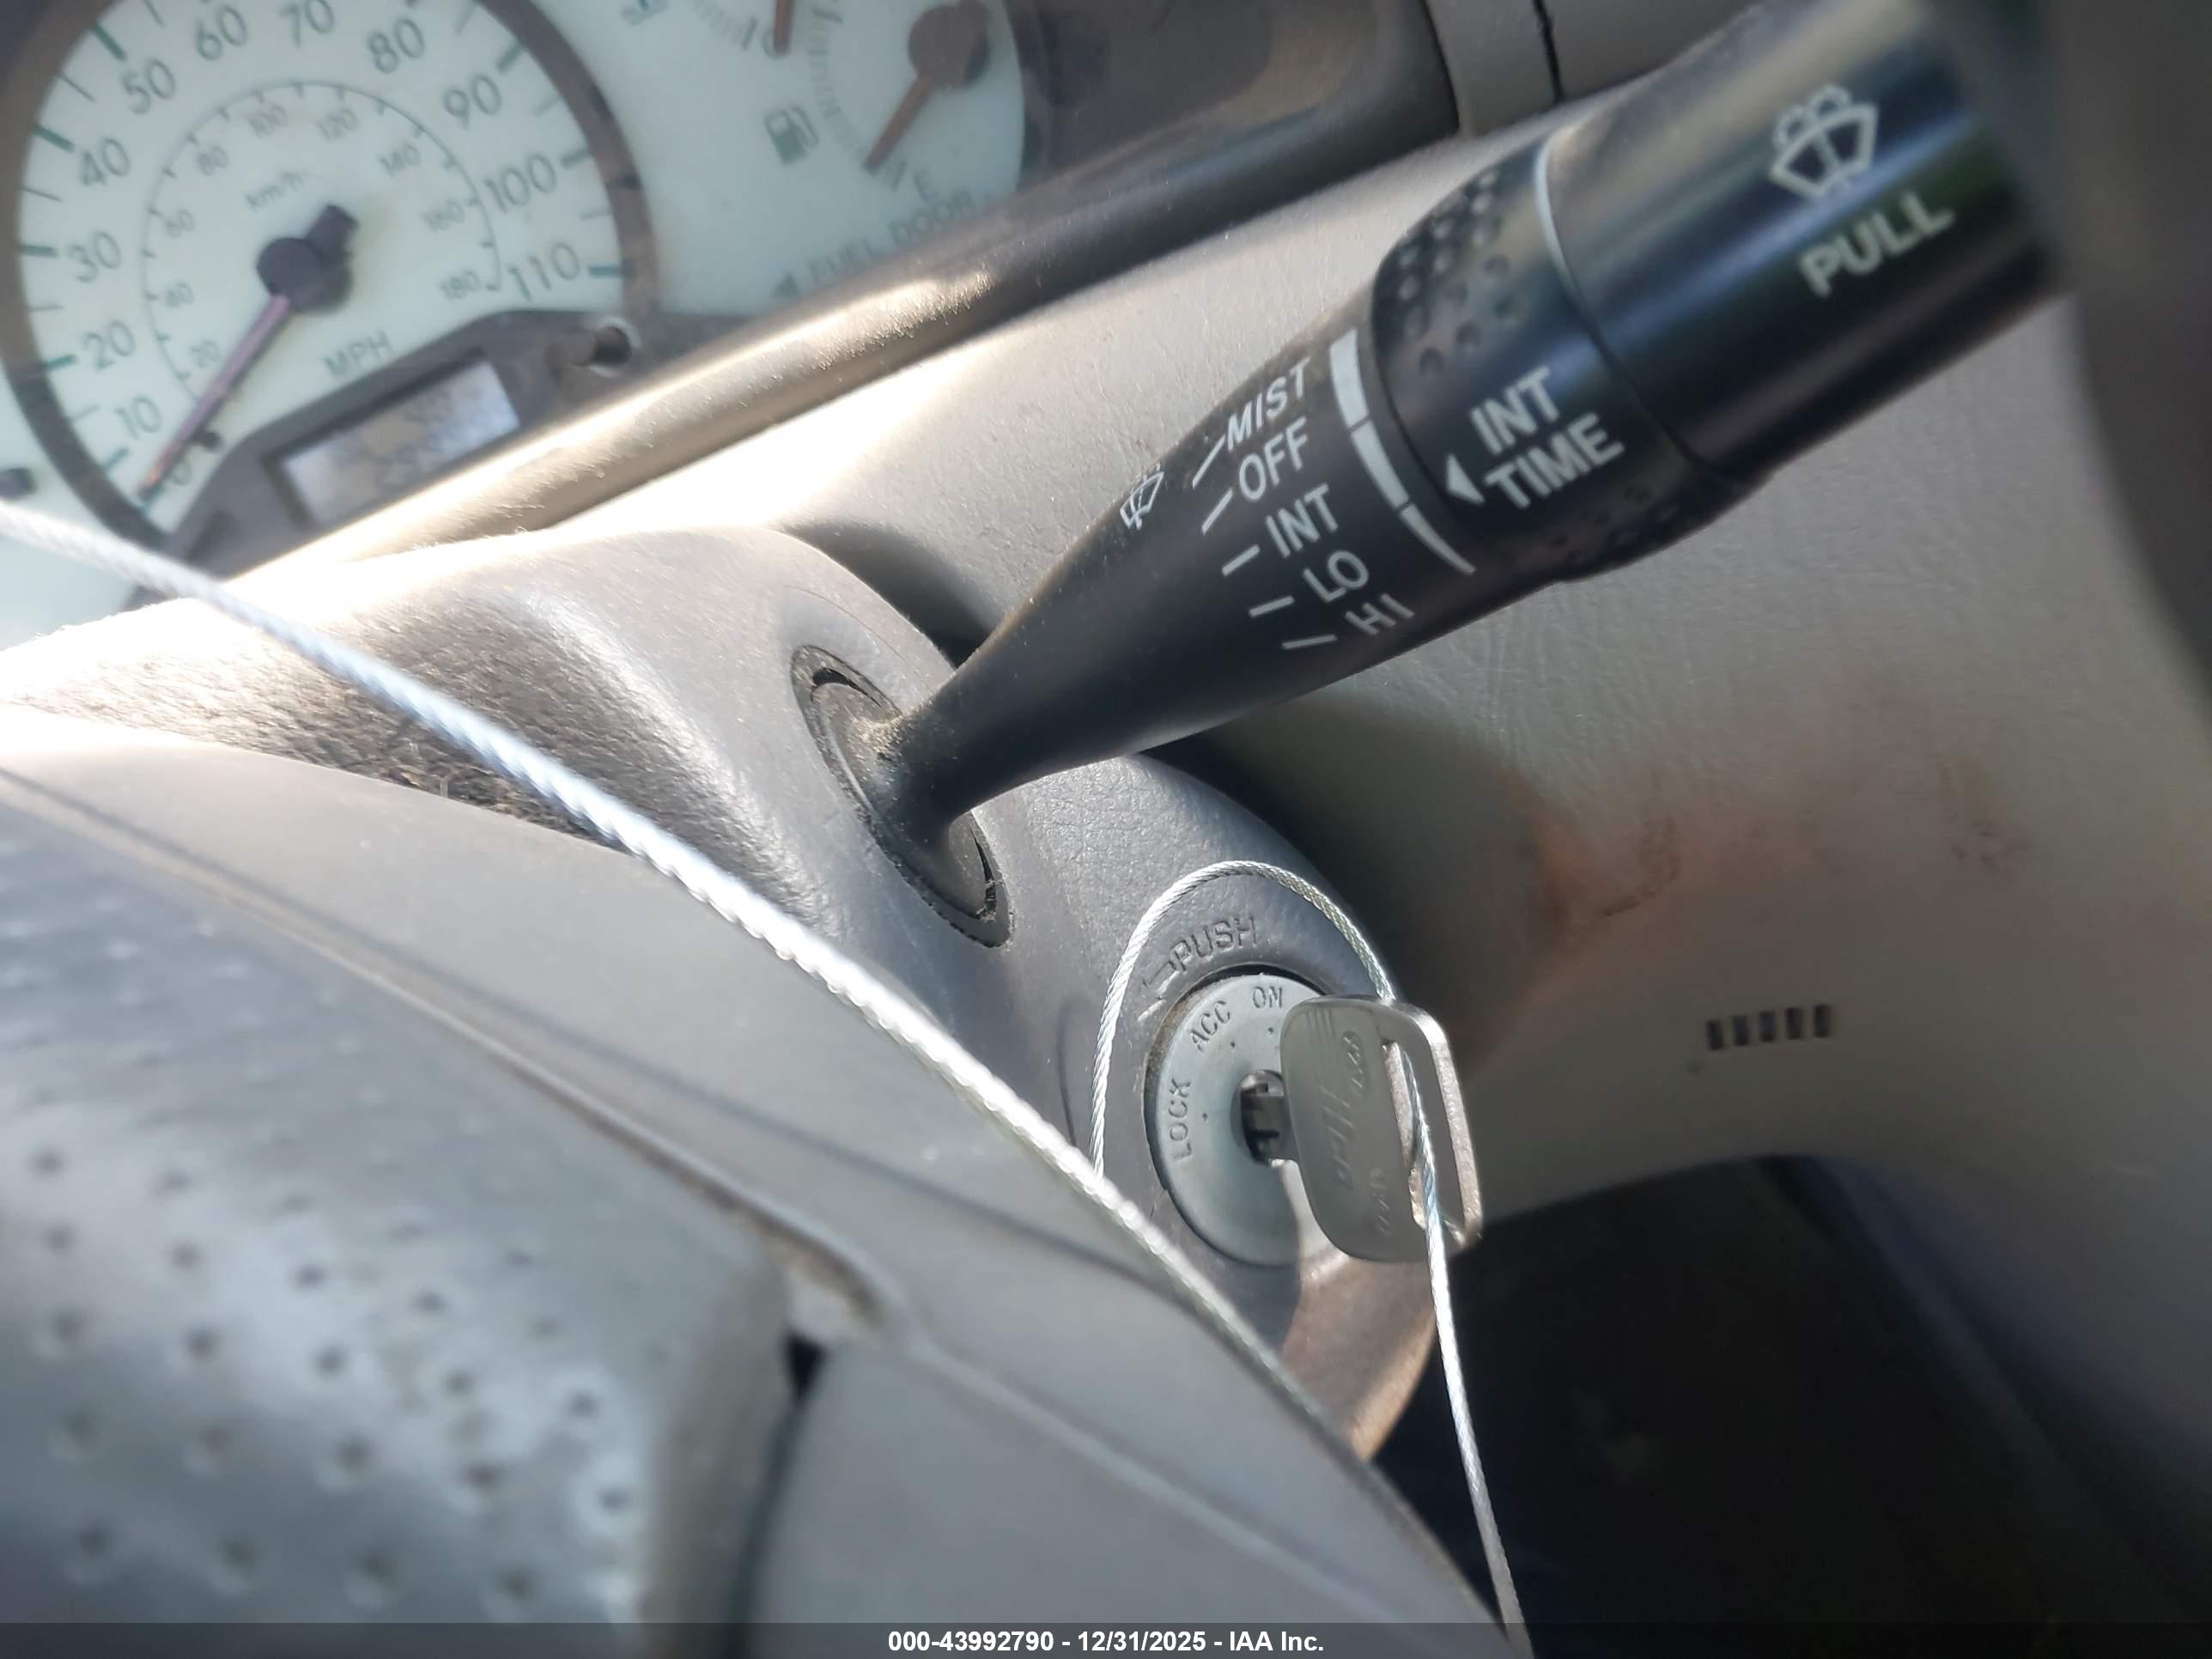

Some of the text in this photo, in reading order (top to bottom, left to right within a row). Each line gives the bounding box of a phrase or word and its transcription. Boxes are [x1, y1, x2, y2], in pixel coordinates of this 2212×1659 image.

[193, 9, 248, 60] 60
[280, 0, 336, 46] 70
[367, 17, 425, 74] 80
[121, 58, 176, 114] 50
[443, 74, 502, 131] 90
[250, 105, 289, 137] 100
[316, 106, 359, 143] 120
[79, 137, 131, 188] 40
[194, 146, 230, 176] 80
[377, 143, 422, 176] 140
[484, 152, 558, 215] 100
[67, 232, 123, 283] 30
[1798, 191, 1956, 297] PULL
[440, 270, 482, 301] 180
[507, 241, 581, 301] 110
[86, 320, 136, 370] 20
[191, 339, 222, 368] 20
[324, 331, 392, 380] MPH
[115, 395, 162, 440] 10
[1227, 359, 1310, 452] MIST
[1469, 368, 1560, 456] INT
[1237, 416, 1308, 501] OFF
[1483, 413, 1626, 510] TIME
[1266, 483, 1341, 558] INT
[1303, 550, 1370, 604] LO
[1345, 592, 1415, 635] HI
[1170, 915, 1258, 974] PUSH
[1251, 985, 1284, 1010] ON
[1188, 1000, 1232, 1052] ACC
[1168, 1078, 1193, 1162] LOCK
